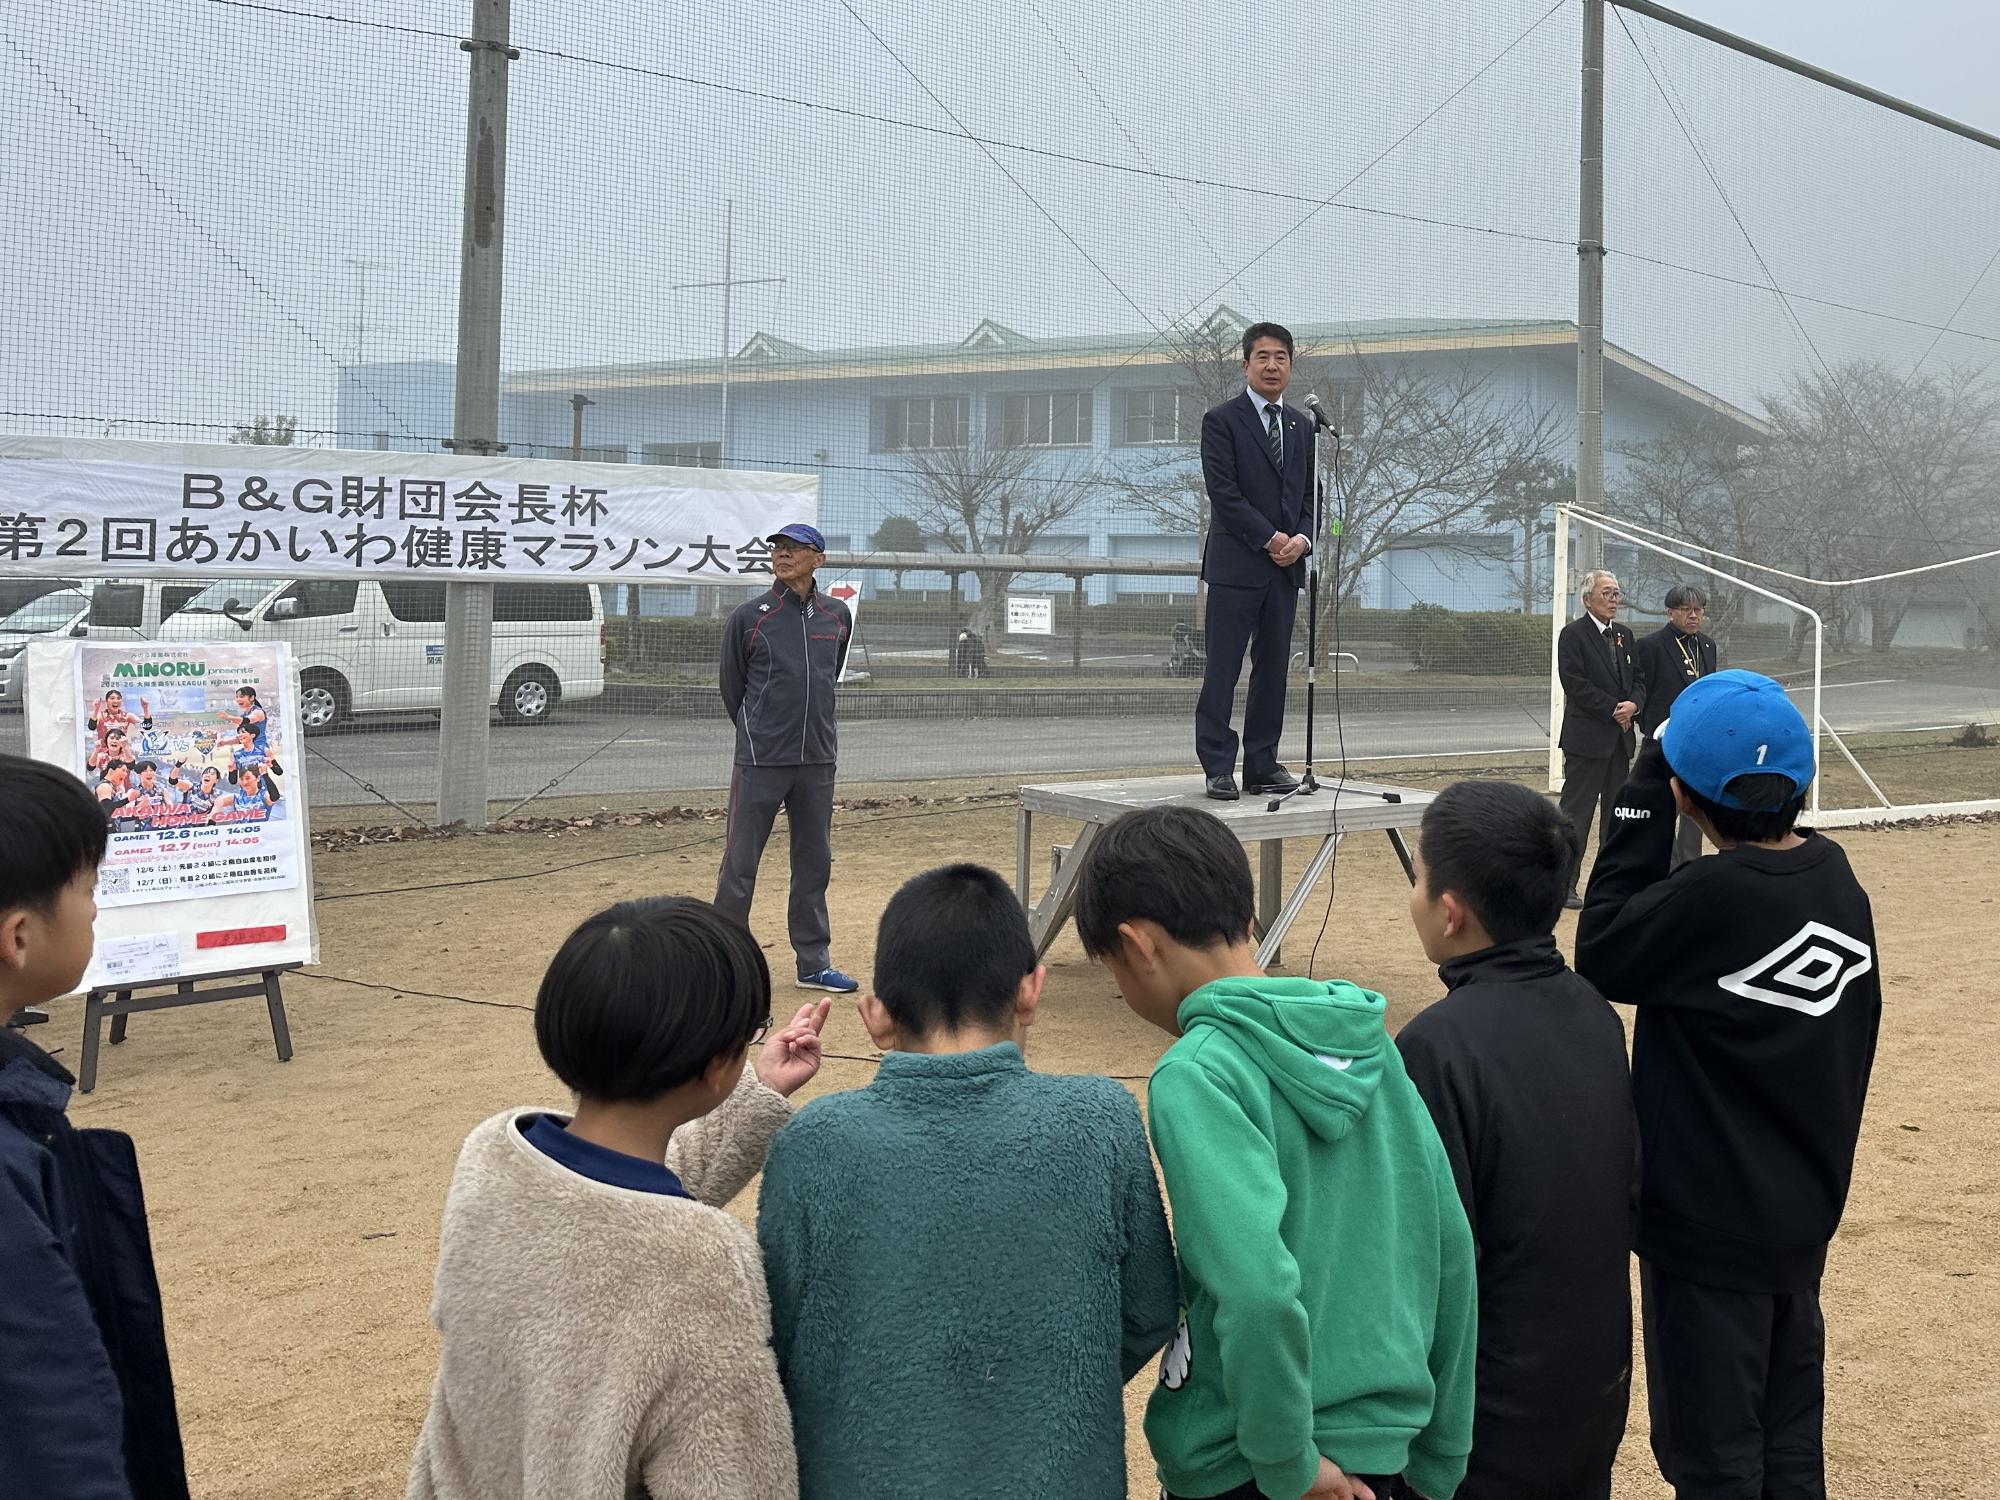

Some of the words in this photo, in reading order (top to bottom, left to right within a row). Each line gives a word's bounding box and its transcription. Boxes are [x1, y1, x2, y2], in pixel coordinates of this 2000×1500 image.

[183, 472, 609, 527] B&G財団会長杯
[0, 512, 774, 575] 第2回あかいわ健康マラソン大会
[208, 667, 254, 675] presents
[1756, 744, 1768, 765] 1
[111, 803, 192, 819] AKAIWA
[151, 812, 209, 828] HOME
[211, 809, 267, 823] GAME
[114, 834, 150, 842] GAME1
[156, 830, 190, 841] 12.6
[227, 826, 261, 835] 14:05
[114, 847, 153, 855] GAME2
[158, 843, 191, 853] 12.7
[225, 837, 260, 846] 14:05
